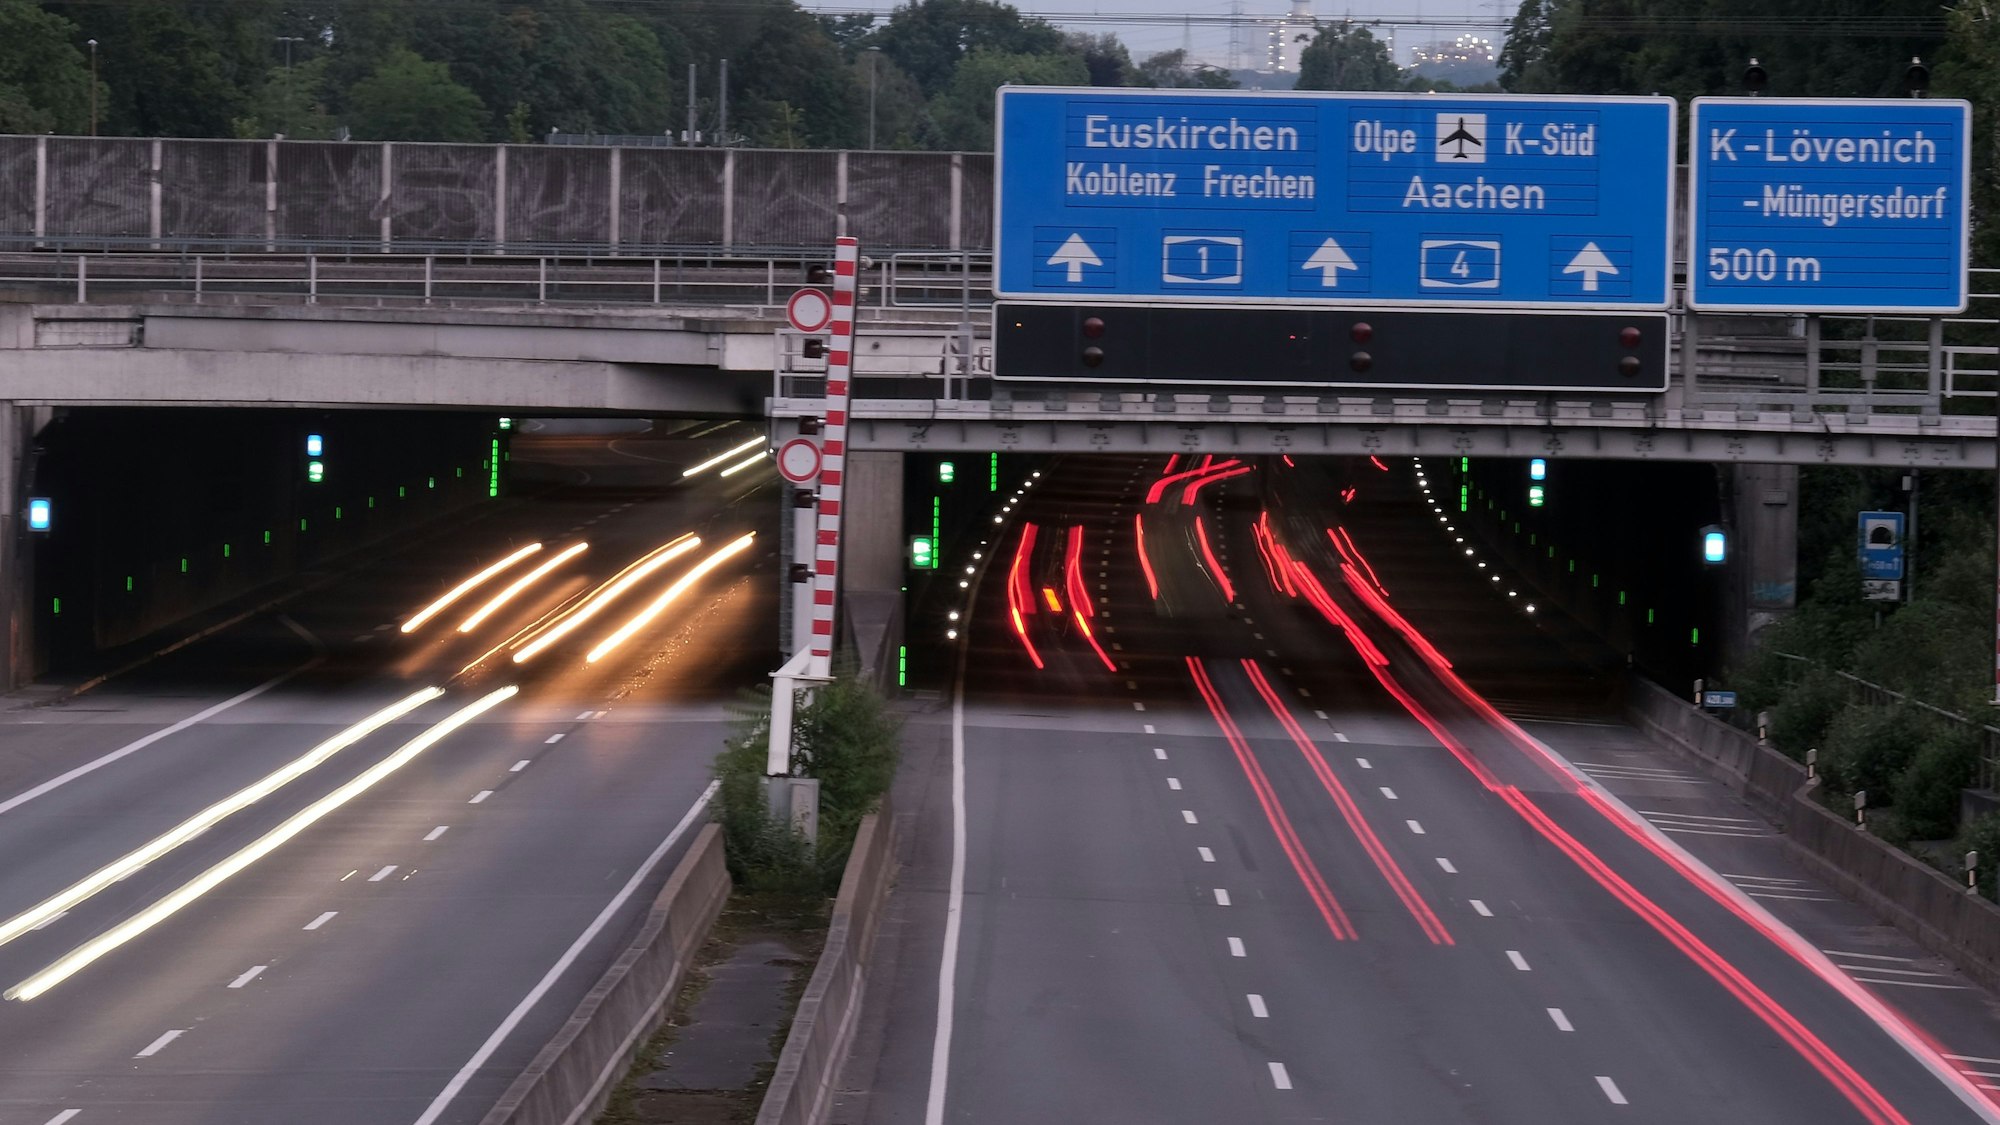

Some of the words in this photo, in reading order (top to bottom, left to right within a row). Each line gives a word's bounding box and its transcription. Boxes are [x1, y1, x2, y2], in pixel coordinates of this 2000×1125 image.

[1087, 115, 1297, 151] Euskirchen
[1354, 119, 1416, 162] Olpe
[1506, 122, 1594, 156] K-Süd
[1711, 128, 1936, 163] K-Lövenich
[1067, 162, 1176, 197] Koblenz
[1204, 164, 1314, 199] Frechen
[1403, 175, 1544, 210] Aachen
[1744, 184, 1947, 227] -Müngersdorf
[1197, 246, 1209, 275] 1
[1450, 250, 1470, 279] 4
[1709, 247, 1777, 282] 500
[1787, 257, 1821, 282] m
